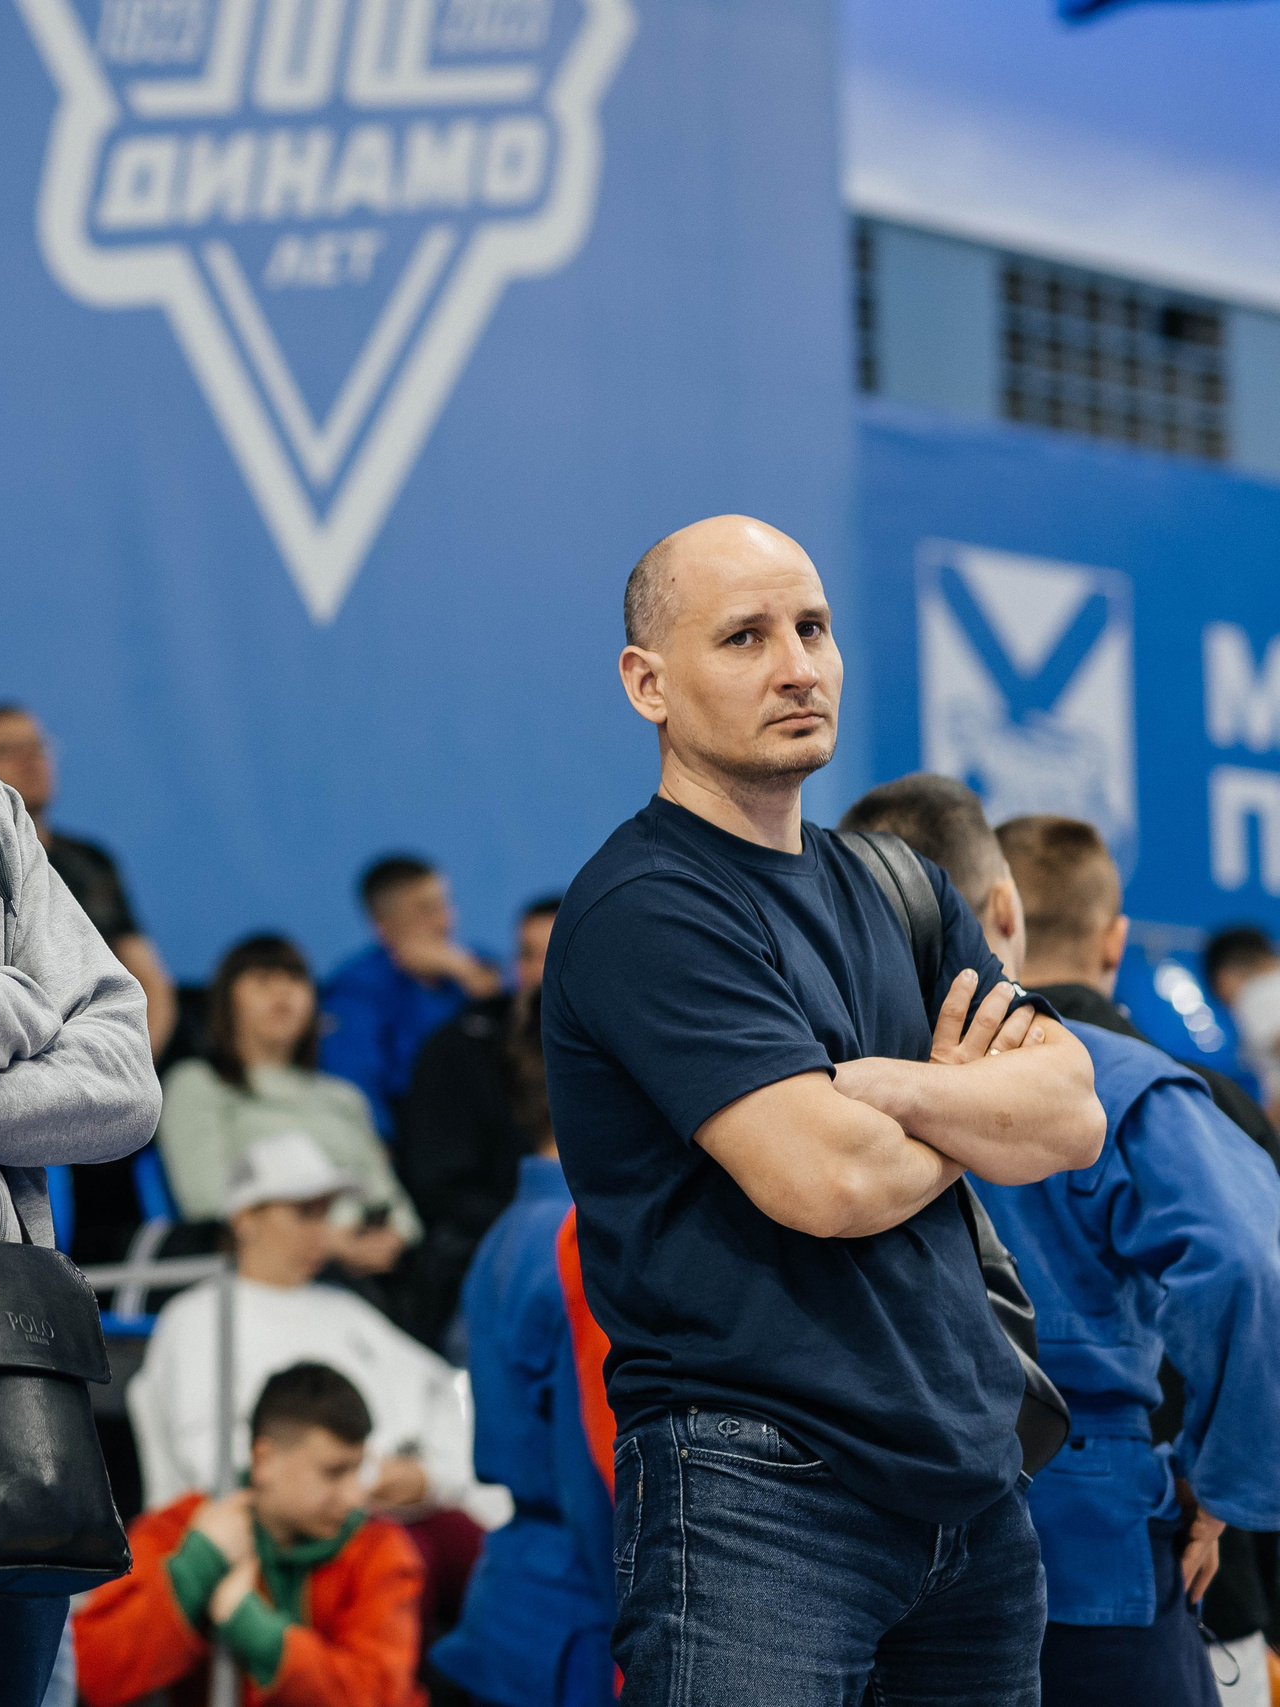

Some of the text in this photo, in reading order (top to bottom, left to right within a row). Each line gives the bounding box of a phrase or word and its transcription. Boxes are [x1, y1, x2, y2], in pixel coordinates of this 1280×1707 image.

[97, 115, 551, 232] ДИНАМО
[264, 230, 386, 290] ЛЕТ
[4, 1310, 55, 1339] POLO
